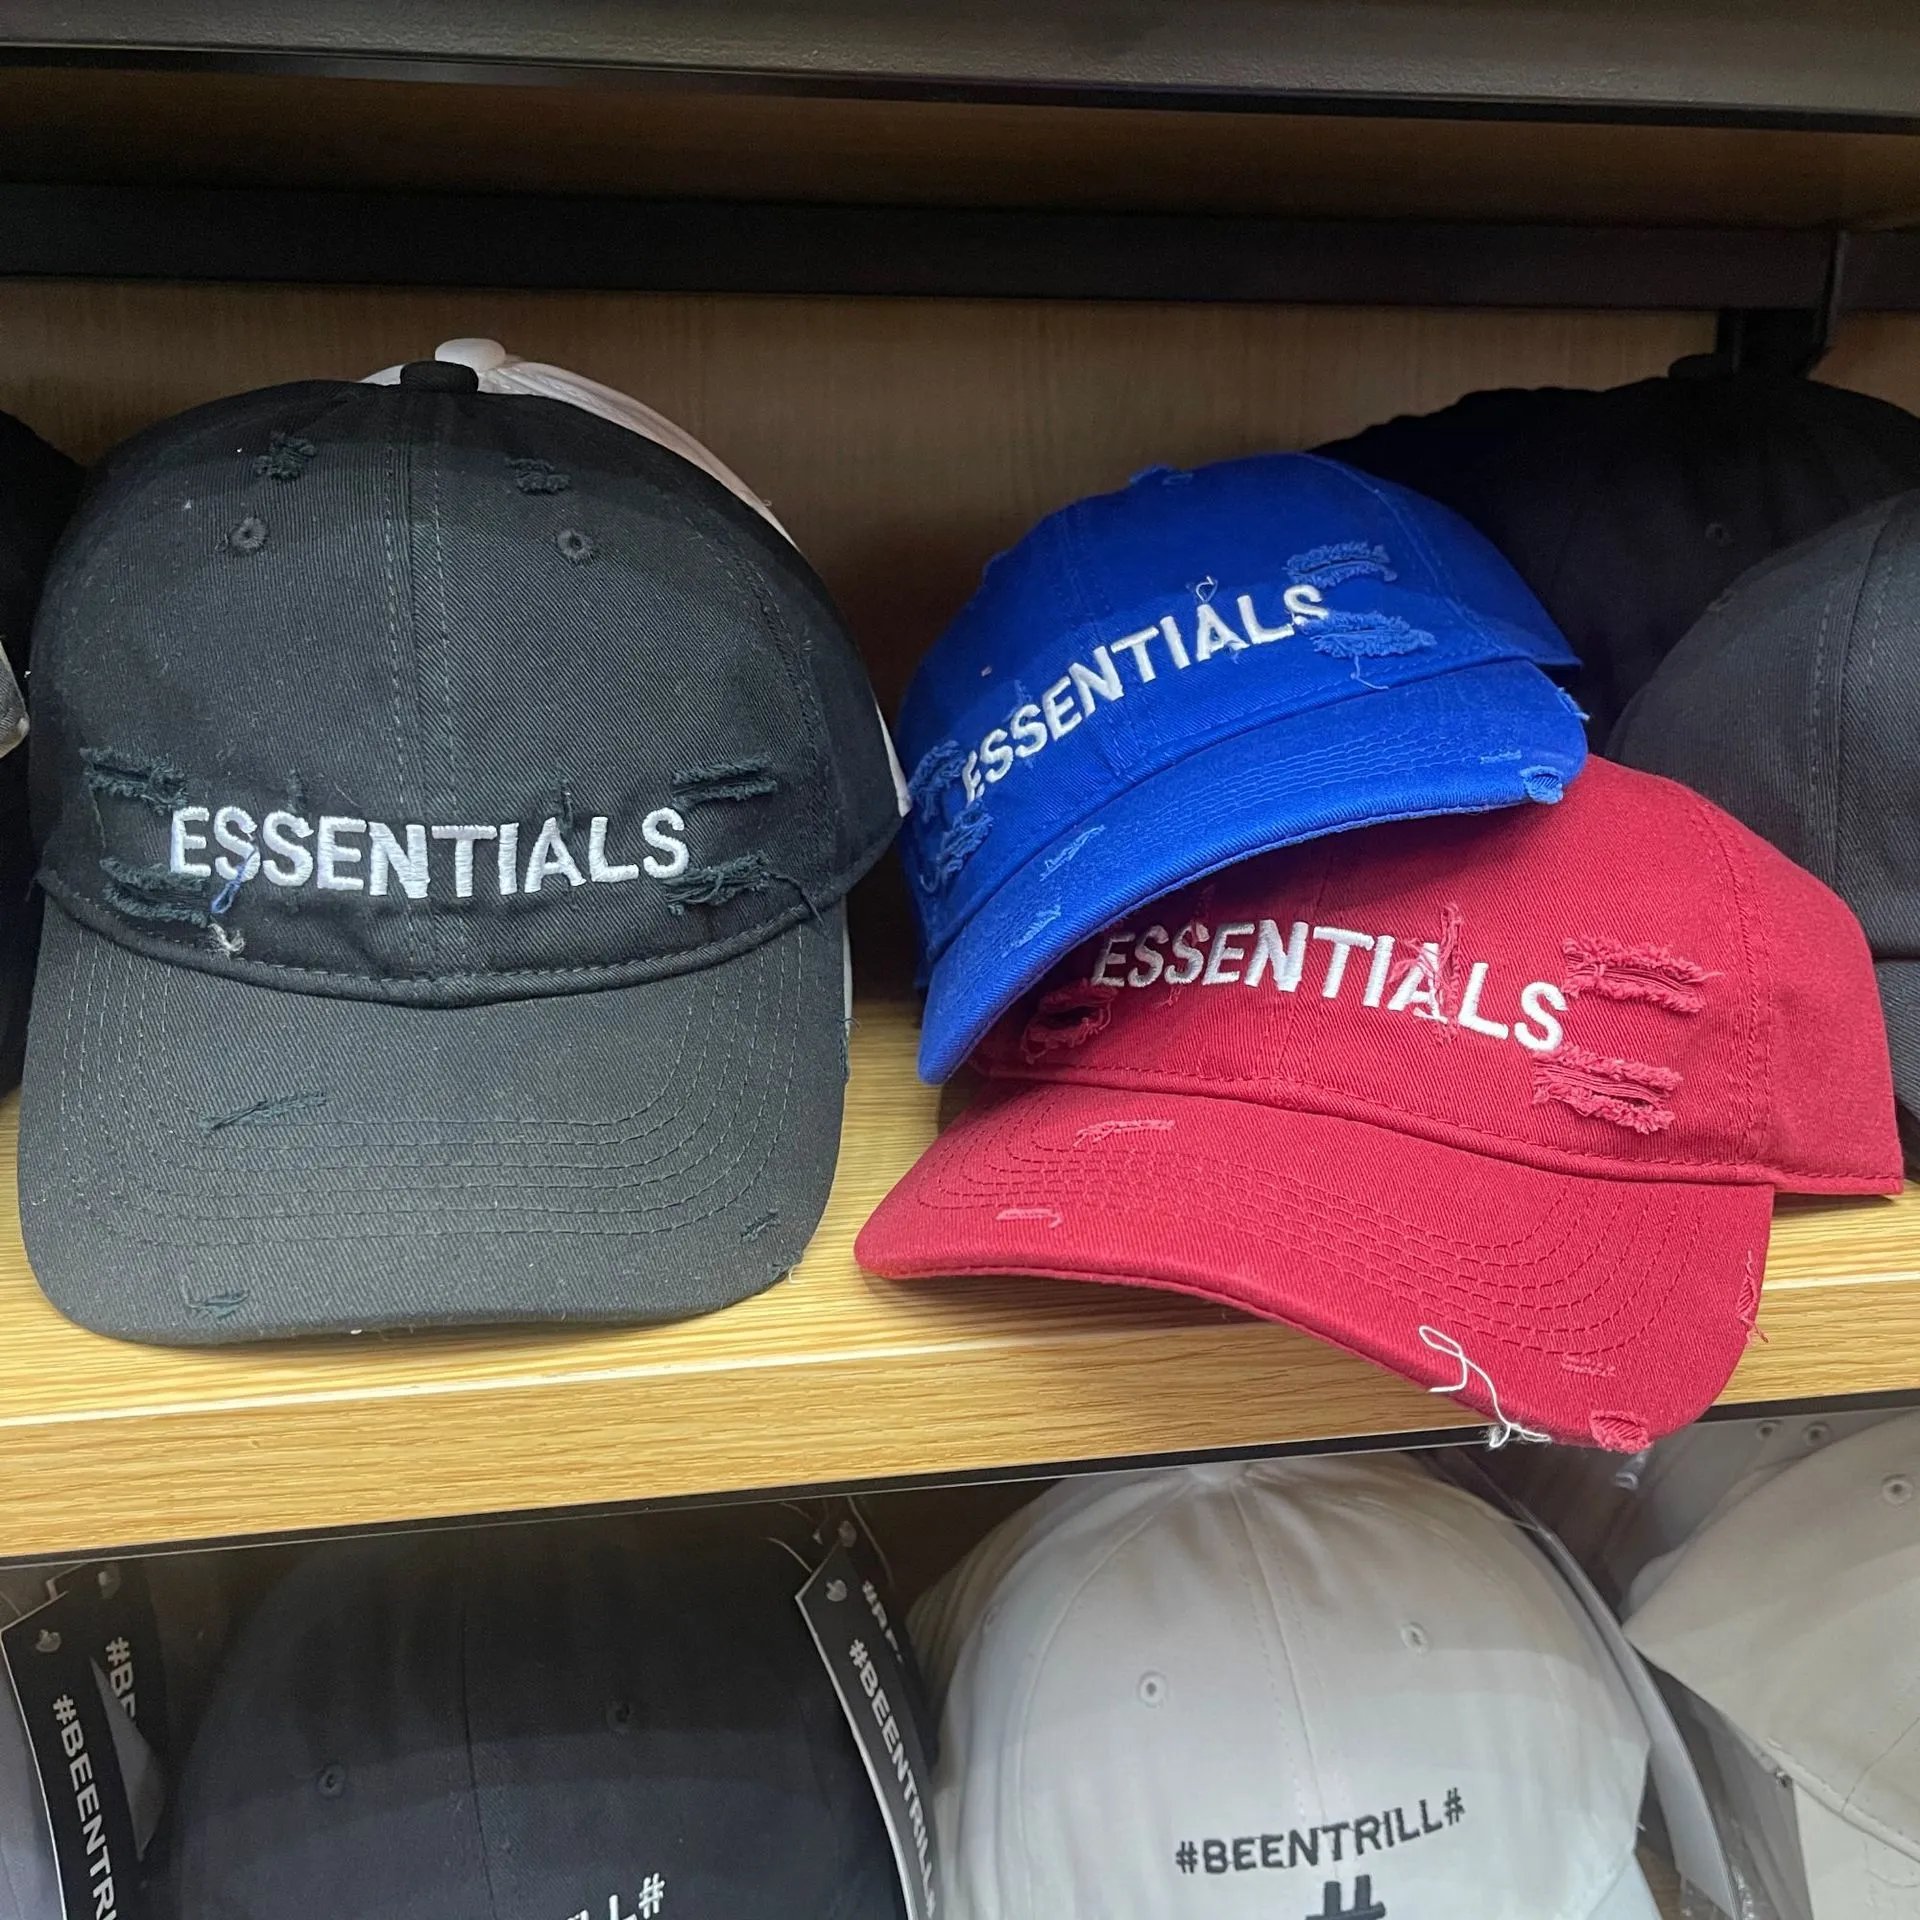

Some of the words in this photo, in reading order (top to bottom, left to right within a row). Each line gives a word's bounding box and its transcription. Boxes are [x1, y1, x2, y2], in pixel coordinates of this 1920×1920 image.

[961, 585, 1330, 802] ESSENTIALS
[169, 806, 690, 899] ESSENTIALS
[1092, 918, 1568, 1051] ESSENTIALS
[1176, 1786, 1466, 1874] #BEENTRILL#
